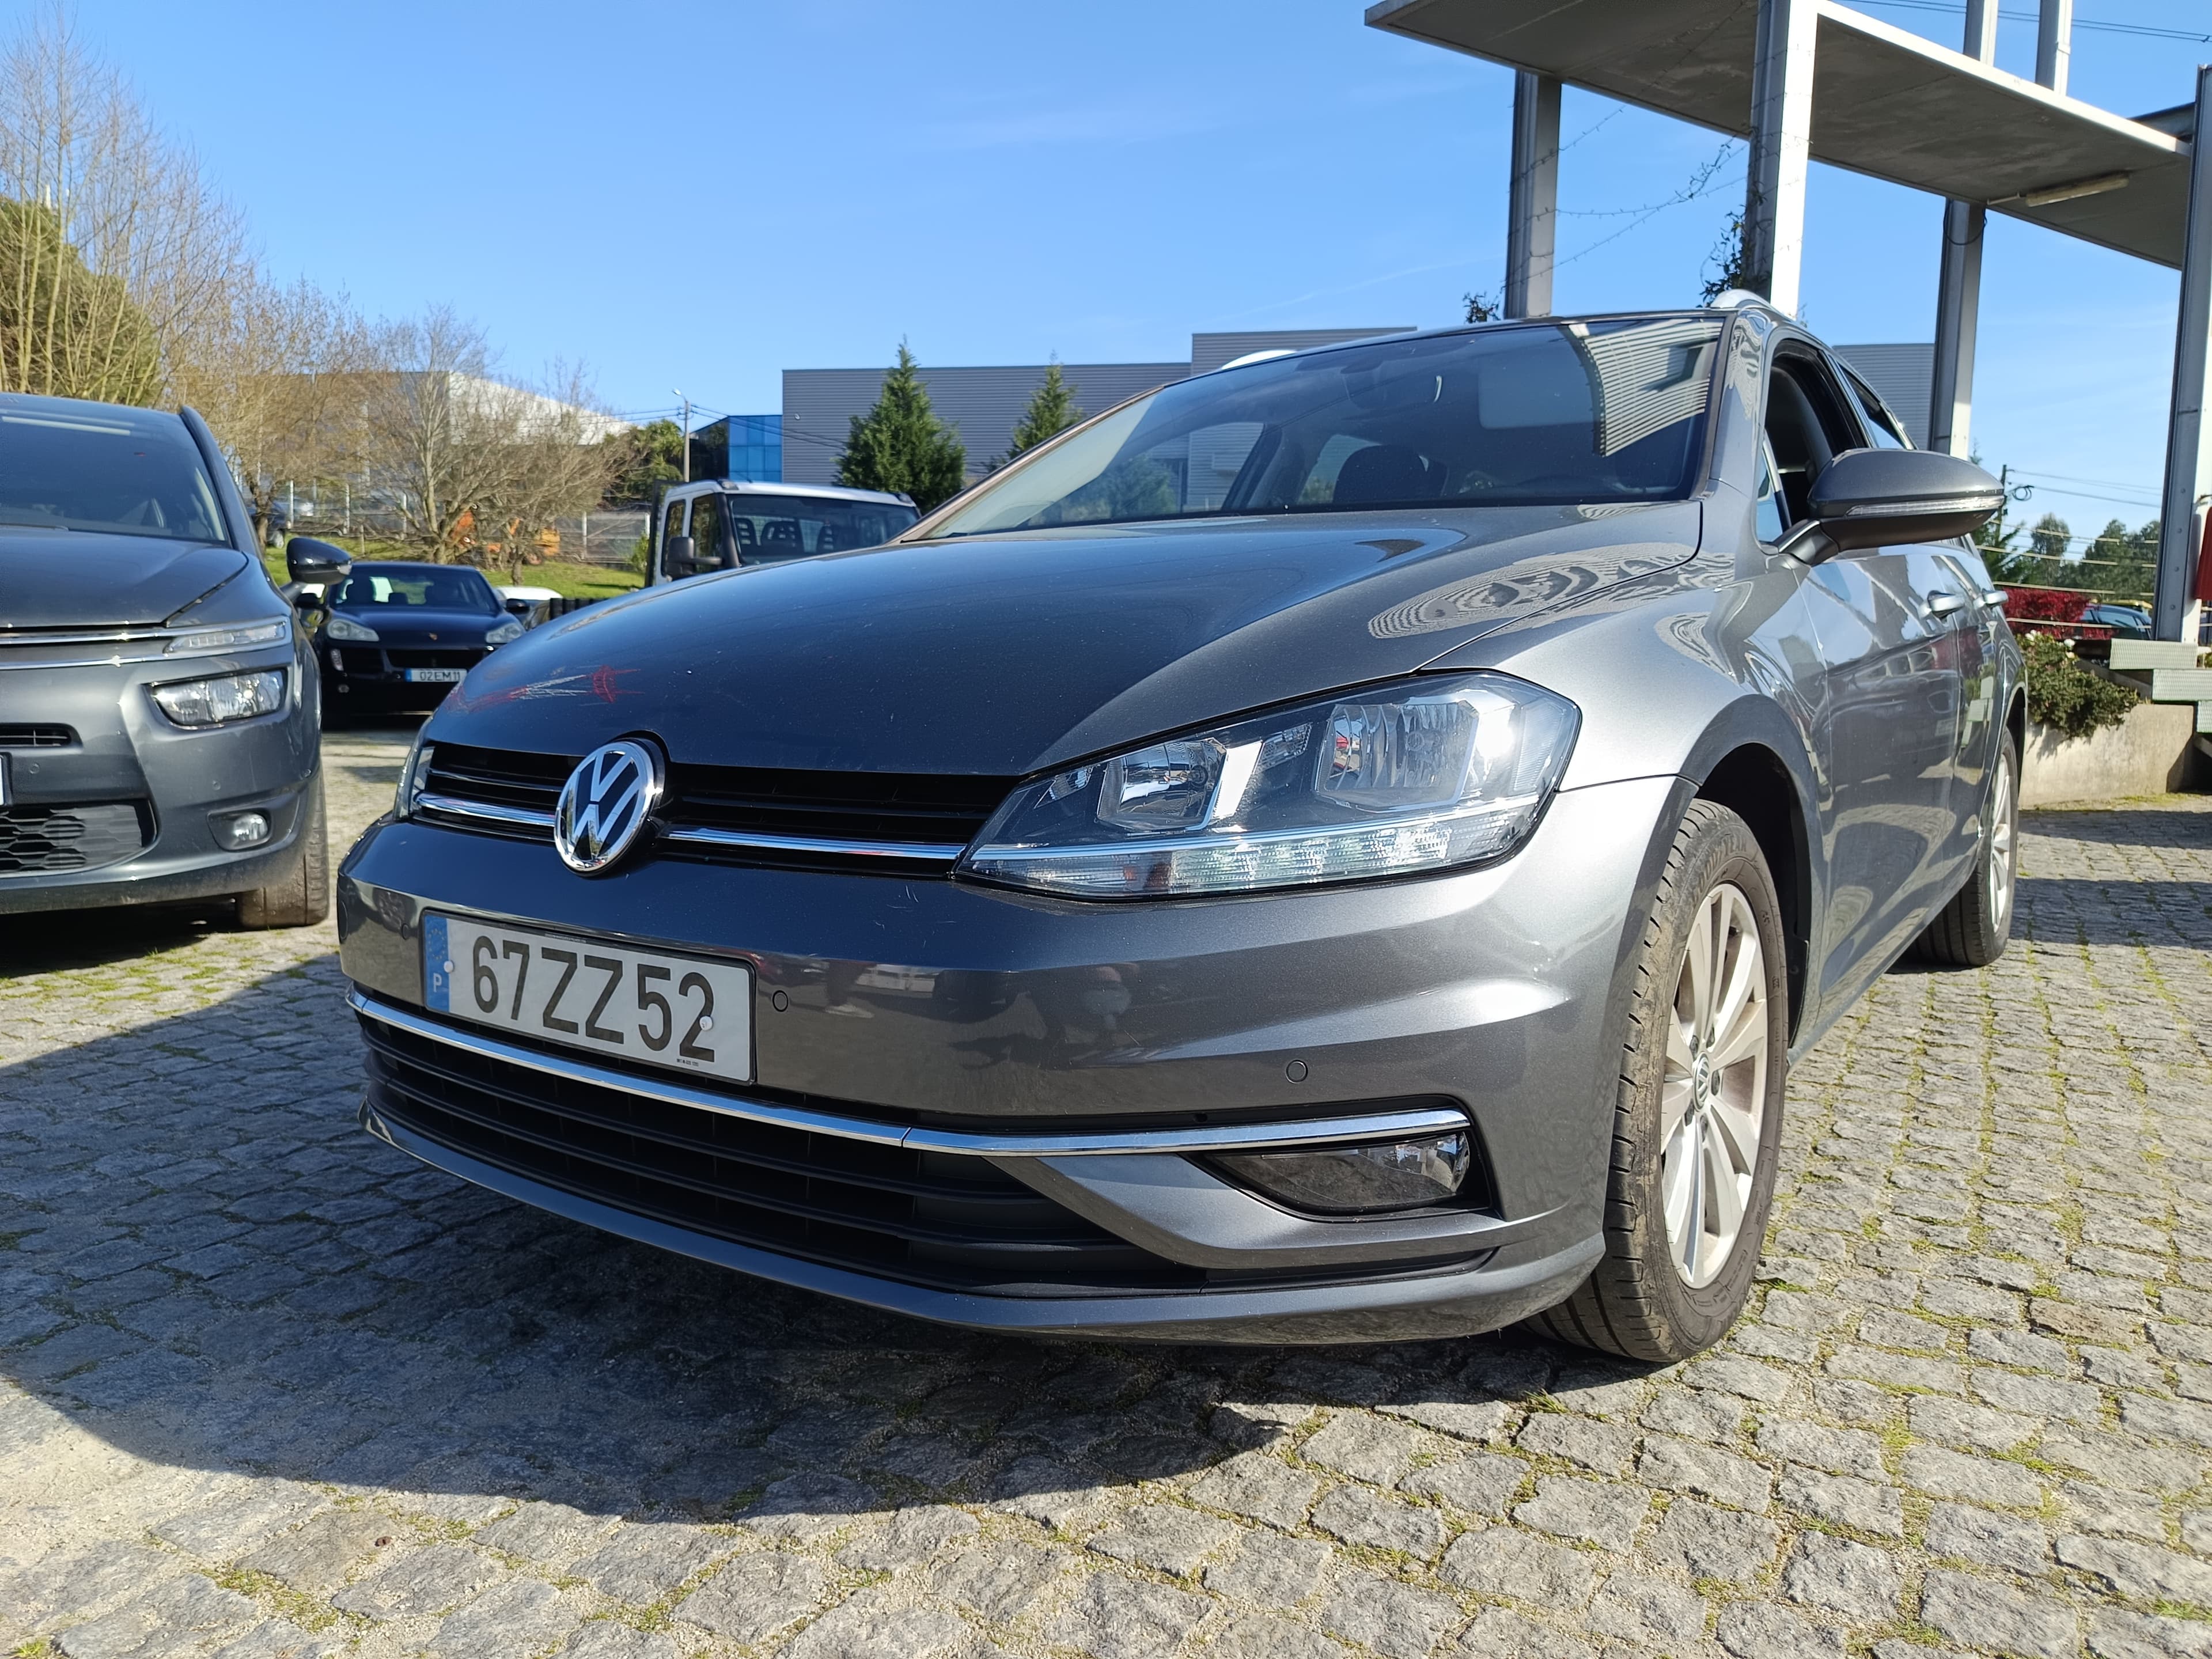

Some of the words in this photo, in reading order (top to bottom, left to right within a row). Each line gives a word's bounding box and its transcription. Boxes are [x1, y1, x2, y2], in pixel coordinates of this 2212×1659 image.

[419, 671, 460, 681] 02EM11
[433, 972, 442, 992] P
[472, 935, 714, 1062] 67ZZ52
